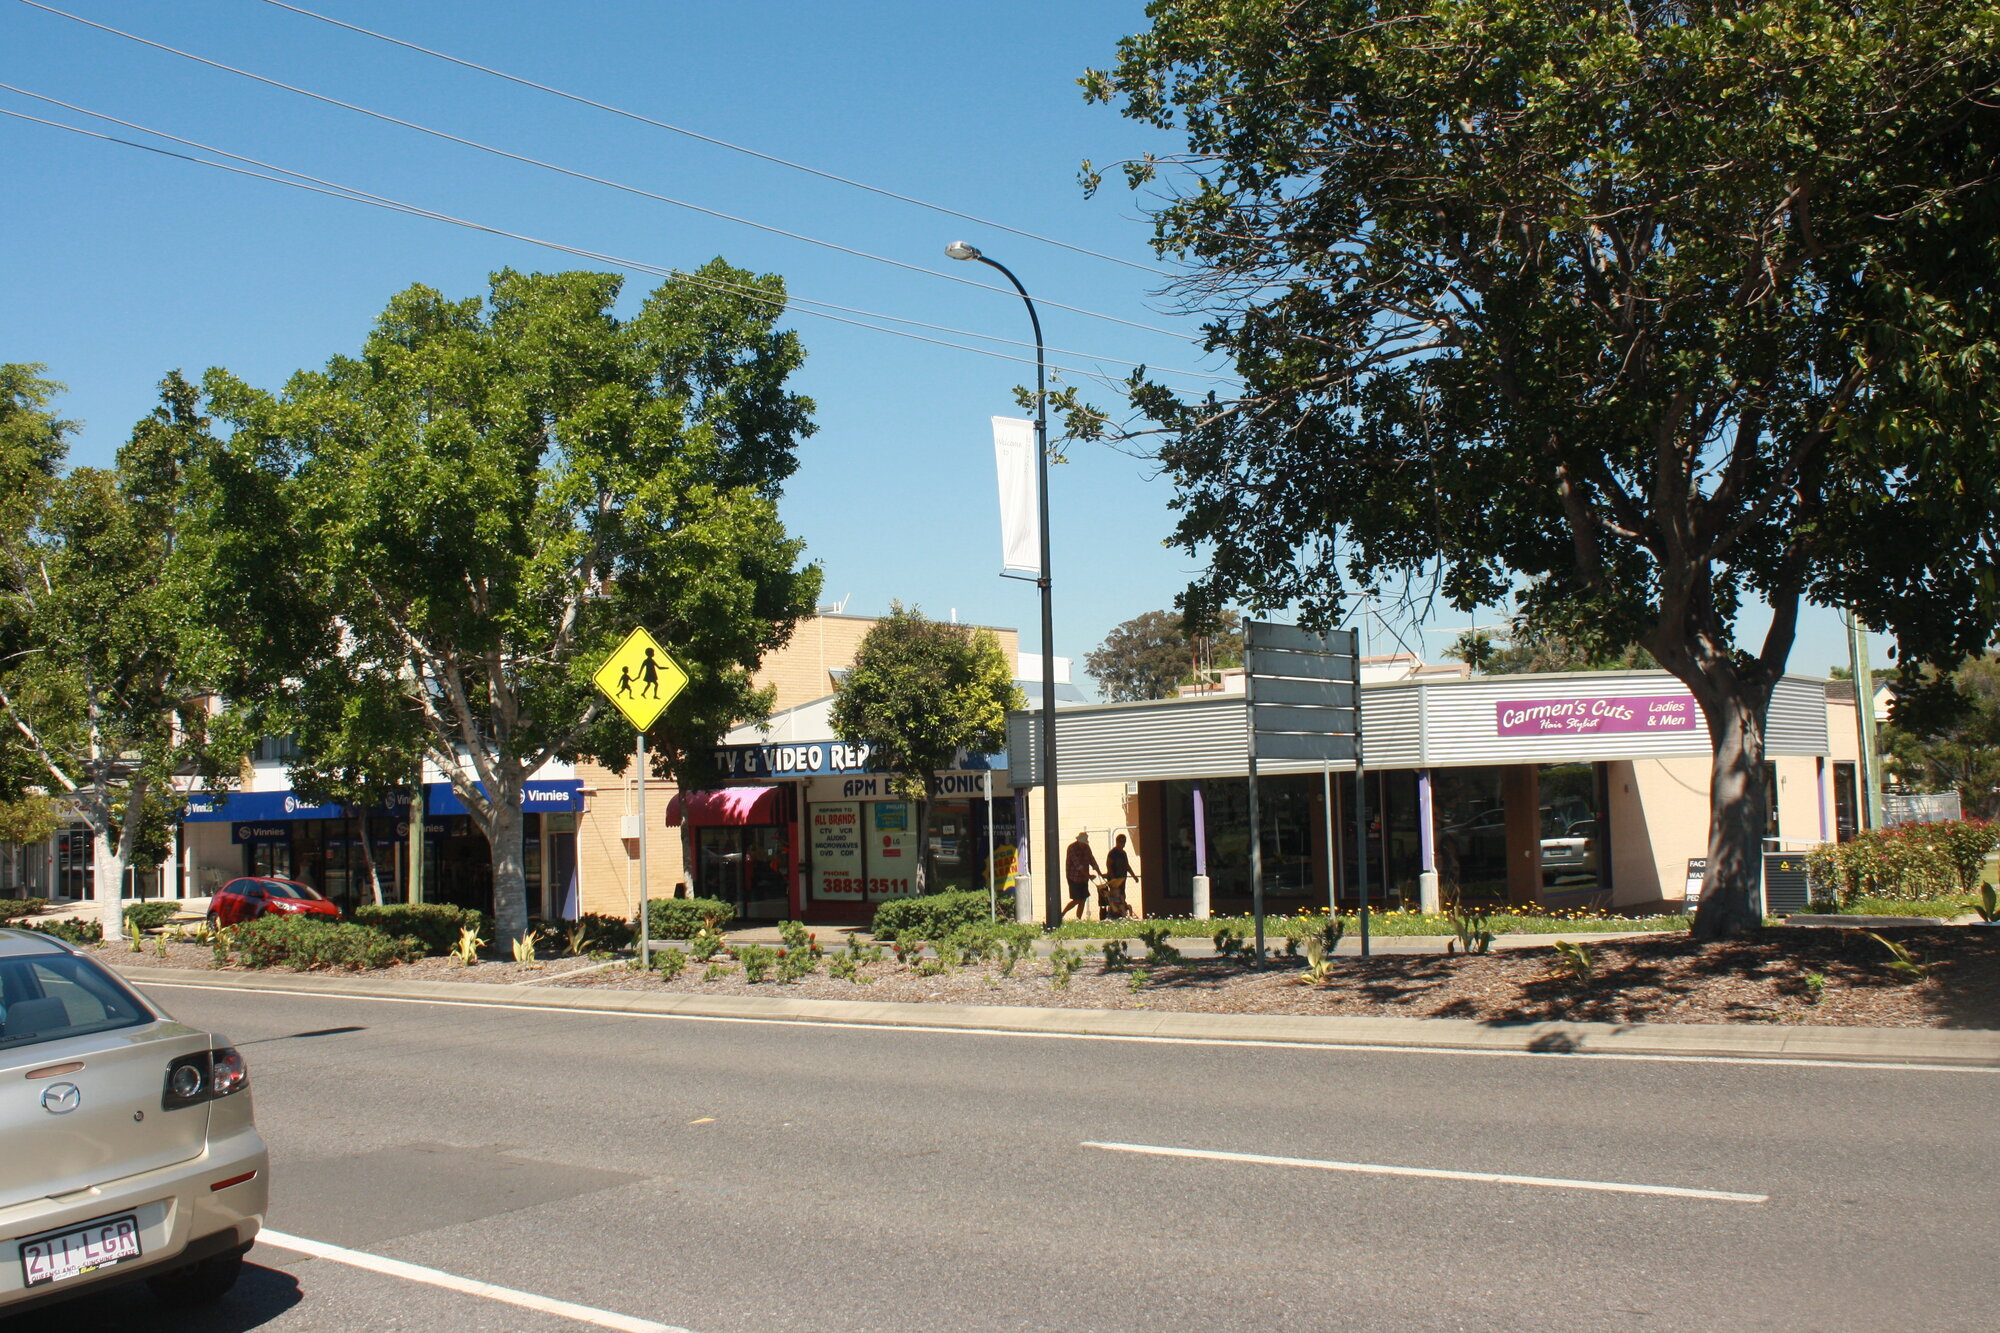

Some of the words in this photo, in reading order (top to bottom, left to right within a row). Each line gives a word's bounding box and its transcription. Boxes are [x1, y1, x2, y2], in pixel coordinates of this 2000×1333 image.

[1503, 700, 1586, 727] Carmen's
[1592, 700, 1634, 720] Cuts
[1649, 701, 1685, 713] Ladies
[1540, 718, 1562, 729] Hair
[1566, 717, 1600, 732] Stylist
[1647, 715, 1657, 726] &
[1660, 714, 1686, 726] Men
[714, 751, 738, 773] TV
[744, 750, 757, 773] &
[763, 745, 823, 772] VIDEO
[830, 744, 872, 775] REP
[528, 789, 570, 801] Vinnies
[843, 778, 877, 798] APM
[815, 814, 827, 826] ALL
[828, 813, 856, 825] BRANDS
[253, 827, 285, 836] Vinnies
[823, 878, 864, 893] 3883
[869, 878, 908, 893] 3511
